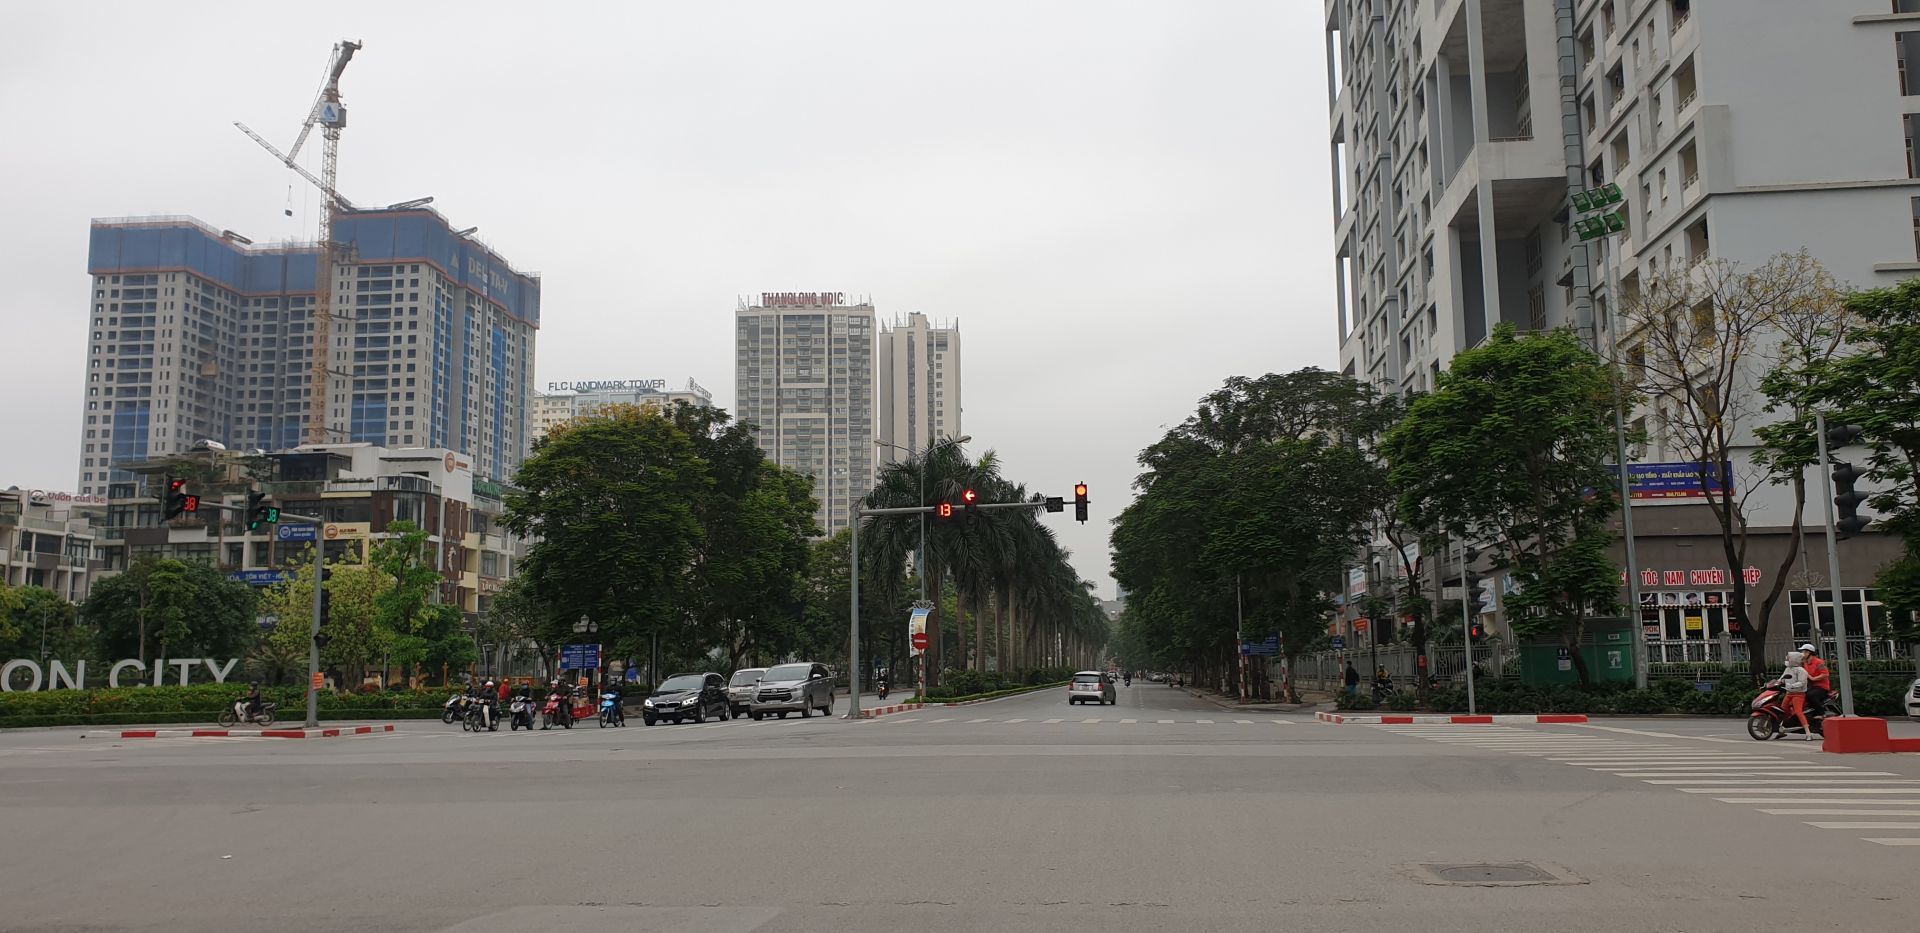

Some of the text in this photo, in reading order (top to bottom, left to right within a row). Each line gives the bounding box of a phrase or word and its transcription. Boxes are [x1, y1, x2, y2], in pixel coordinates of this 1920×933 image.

[820, 292, 844, 304] UDIC
[548, 379, 666, 391] FLC LANDMARK TOWER
[940, 503, 951, 517] 13
[1664, 570, 1685, 586] NAM
[0, 658, 239, 692] ON CITY
